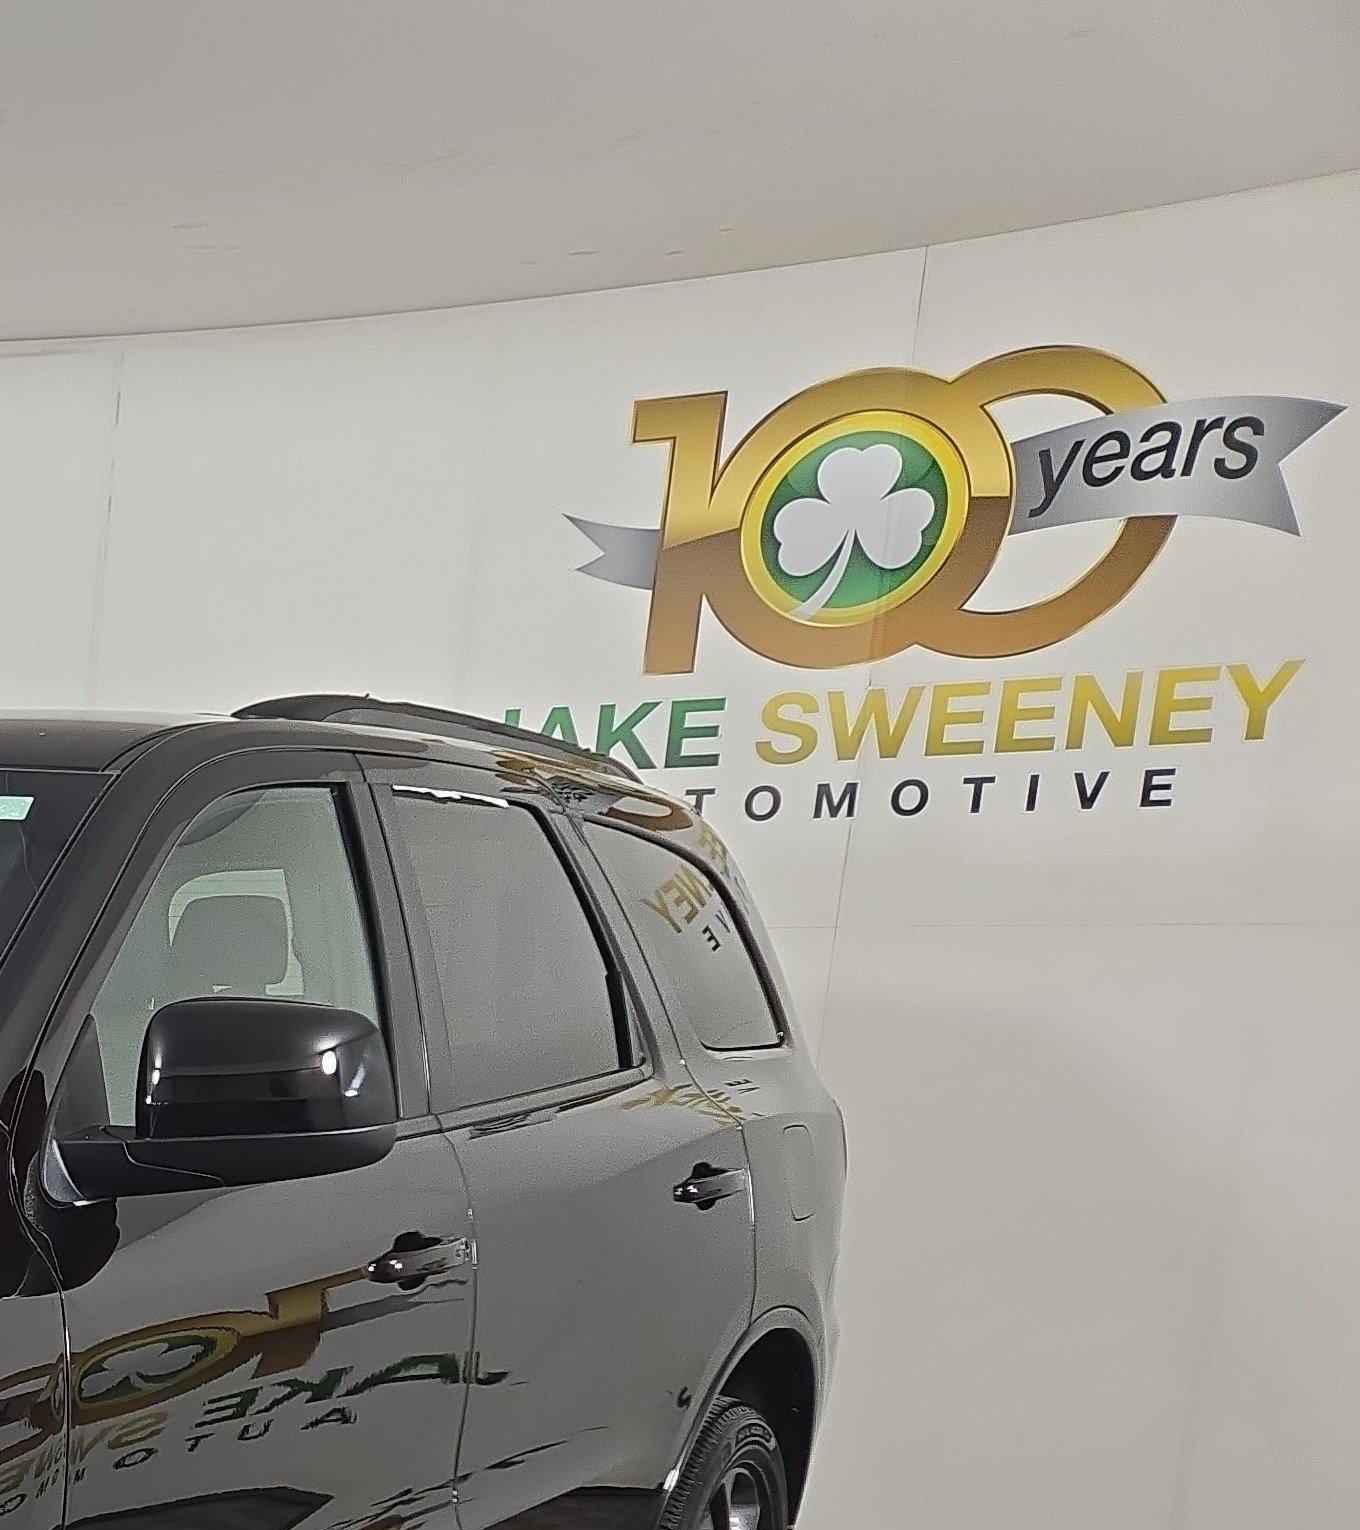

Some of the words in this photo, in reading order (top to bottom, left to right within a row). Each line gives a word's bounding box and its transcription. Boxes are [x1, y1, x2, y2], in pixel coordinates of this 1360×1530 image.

[632, 344, 1178, 676] 100
[1027, 412, 1265, 518] years
[504, 697, 727, 770] AKE
[755, 658, 1306, 766] SWEENEY
[685, 768, 1178, 822] TOMOTIVE
